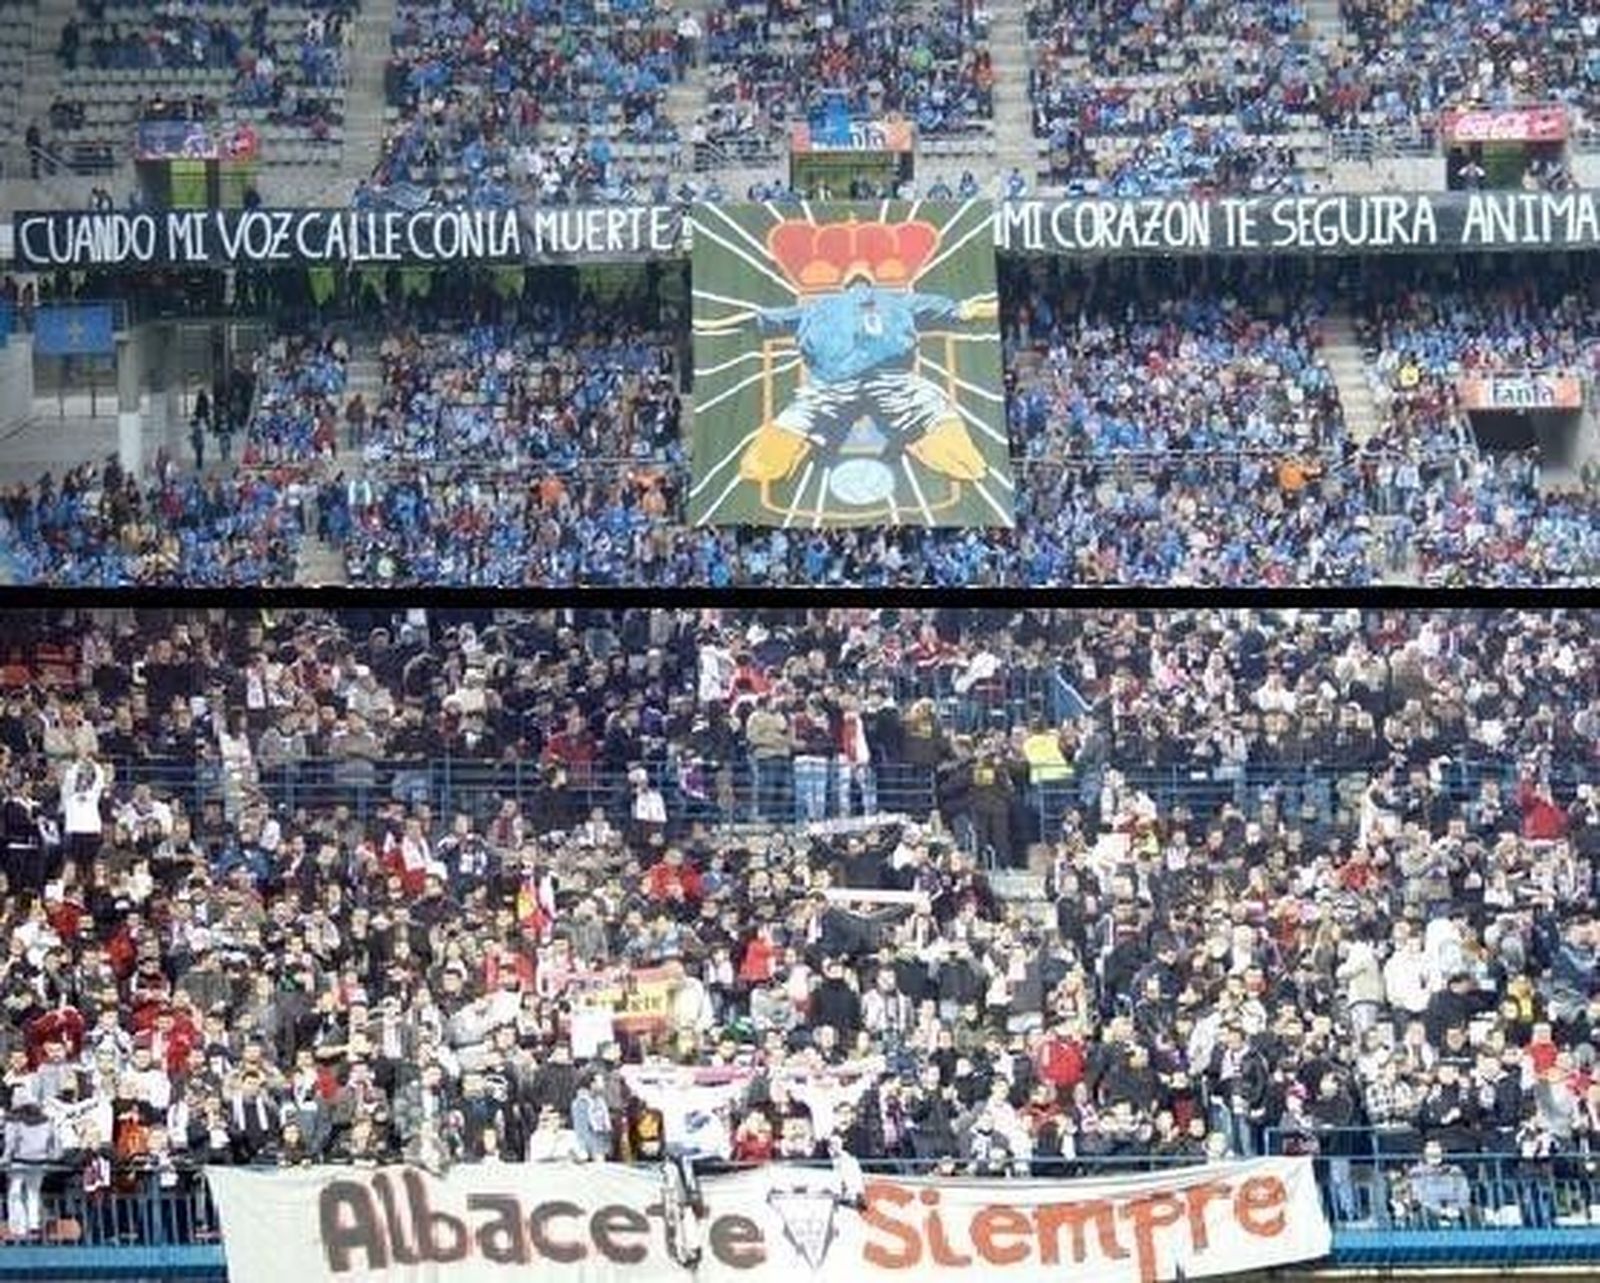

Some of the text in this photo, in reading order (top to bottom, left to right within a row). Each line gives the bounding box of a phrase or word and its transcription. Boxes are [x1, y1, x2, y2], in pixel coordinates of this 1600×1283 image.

[20, 215, 156, 263] CUANDO
[168, 212, 208, 260] MI
[217, 211, 292, 259] VOZ
[296, 211, 403, 260] CALLE
[535, 206, 674, 252] MUERTE
[1004, 201, 1044, 249] MI
[1051, 201, 1210, 249] CORAZON
[1221, 199, 1258, 247] TE
[1272, 195, 1438, 247] SEGUIRA
[862, 1173, 1287, 1283] Siempre
